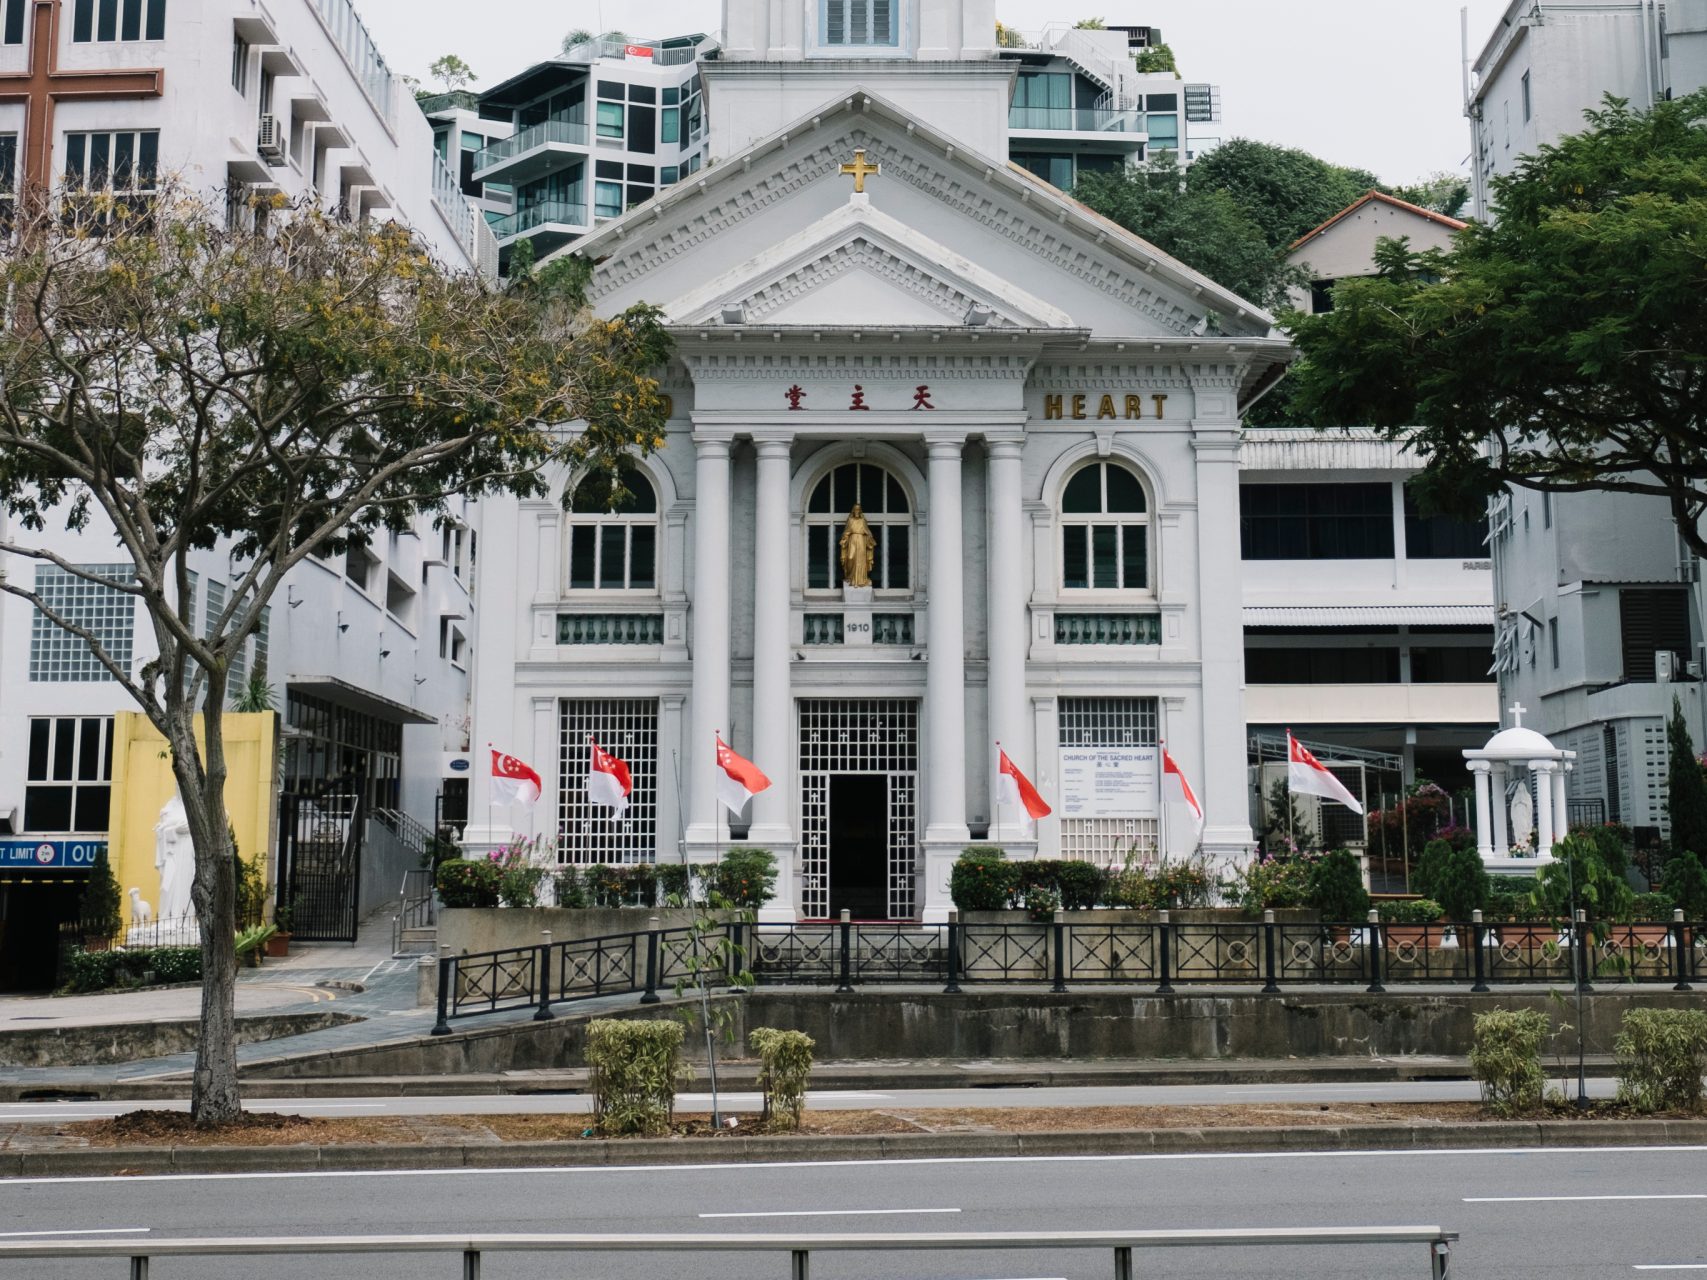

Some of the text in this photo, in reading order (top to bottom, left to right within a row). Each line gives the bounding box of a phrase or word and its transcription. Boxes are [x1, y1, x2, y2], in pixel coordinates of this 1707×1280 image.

[1045, 394, 1168, 420] HEART
[1462, 561, 1492, 570] PARIS
[846, 624, 870, 632] 1910
[9, 847, 35, 859] LIMIT
